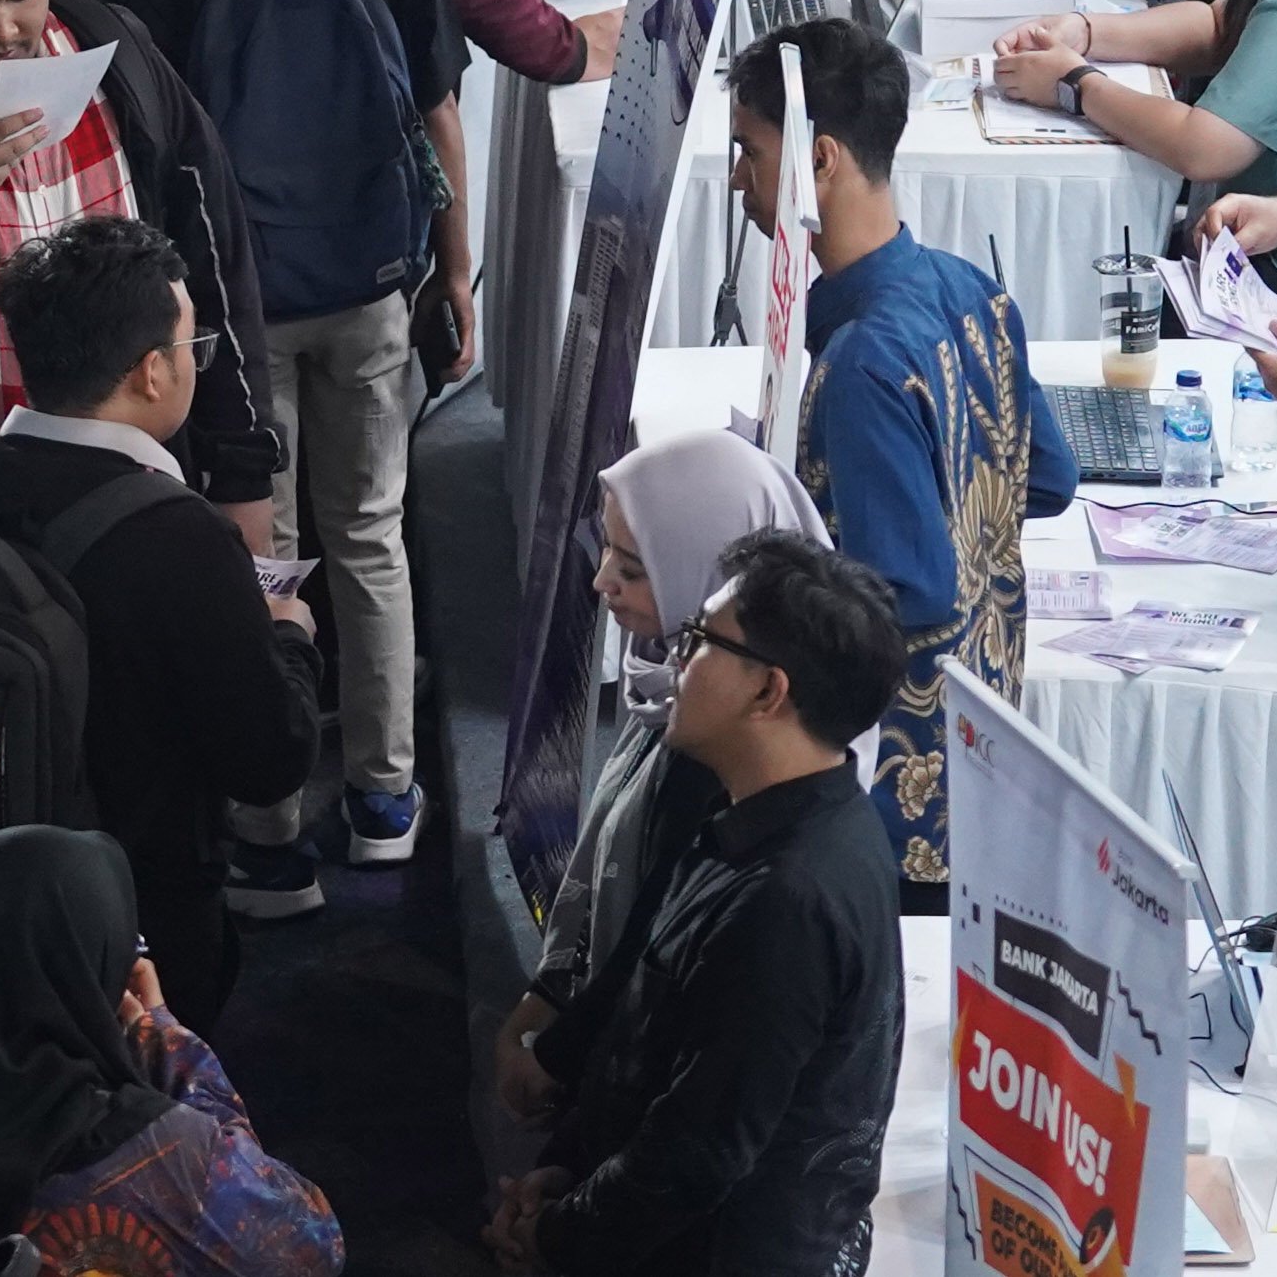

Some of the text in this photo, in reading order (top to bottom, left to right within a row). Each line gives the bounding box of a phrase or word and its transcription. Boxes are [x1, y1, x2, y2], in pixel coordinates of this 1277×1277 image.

[1111, 863, 1169, 926] Jakarta
[1000, 939, 1099, 1016] BANK JAKARTA
[969, 1028, 1112, 1197] JOIN US!
